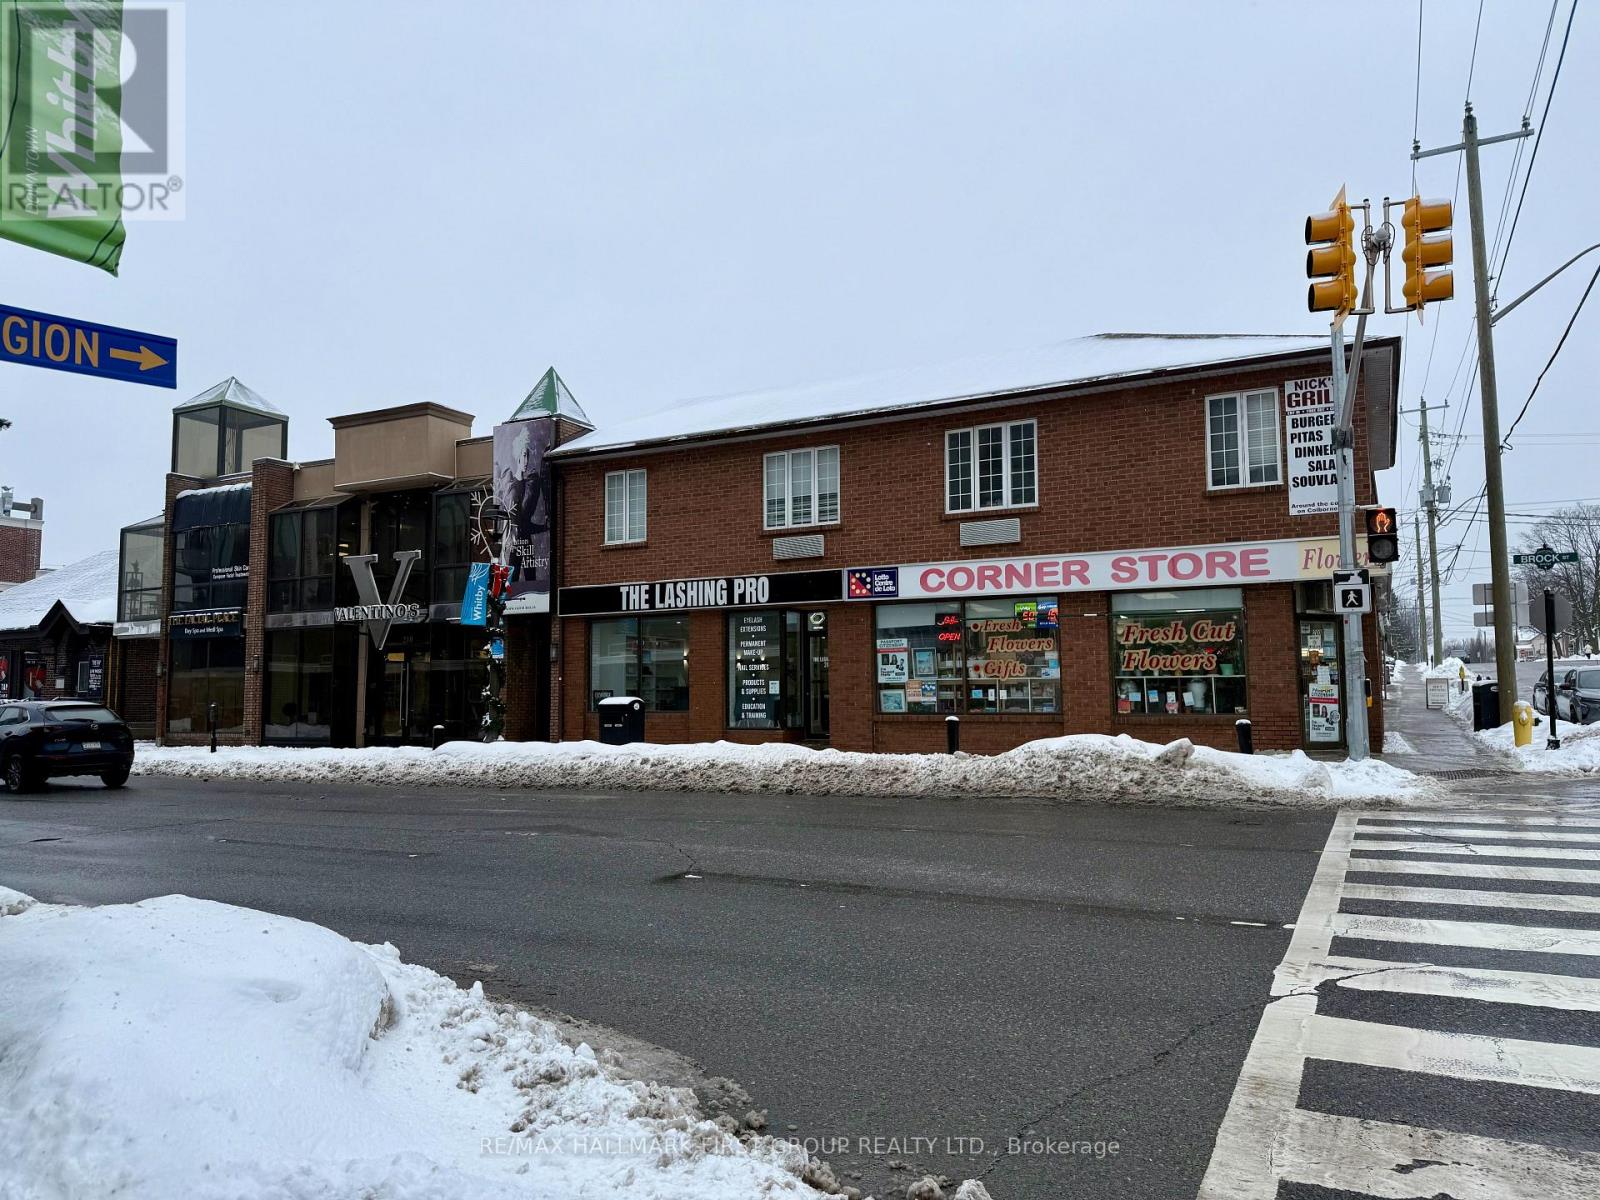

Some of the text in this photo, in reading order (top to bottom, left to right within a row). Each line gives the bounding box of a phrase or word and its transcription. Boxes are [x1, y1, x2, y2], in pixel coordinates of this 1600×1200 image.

[1294, 377, 1334, 391] NICK'
[1287, 389, 1334, 408] GRIL
[1290, 430, 1323, 444] PITAS
[1308, 459, 1337, 472] SALA
[1292, 474, 1338, 488] SOUVLA
[516, 545, 535, 557] Skill
[521, 555, 549, 569] Artistry
[1520, 554, 1560, 563] BROCK
[919, 548, 1271, 593] CORNER STORE
[619, 576, 770, 611] THE LASHING PRO
[472, 585, 486, 621] Whitby
[334, 603, 420, 621] VALENTINO'S
[743, 616, 763, 624] EYELASH
[981, 618, 1021, 632] Fresh
[740, 625, 767, 633] EXTENSIONS
[1121, 620, 1237, 644] Fresh Cut
[938, 632, 961, 641] OPEN
[986, 635, 1053, 653] Flowers
[1121, 648, 1217, 671] Flowers
[982, 660, 1026, 680] Gifts
